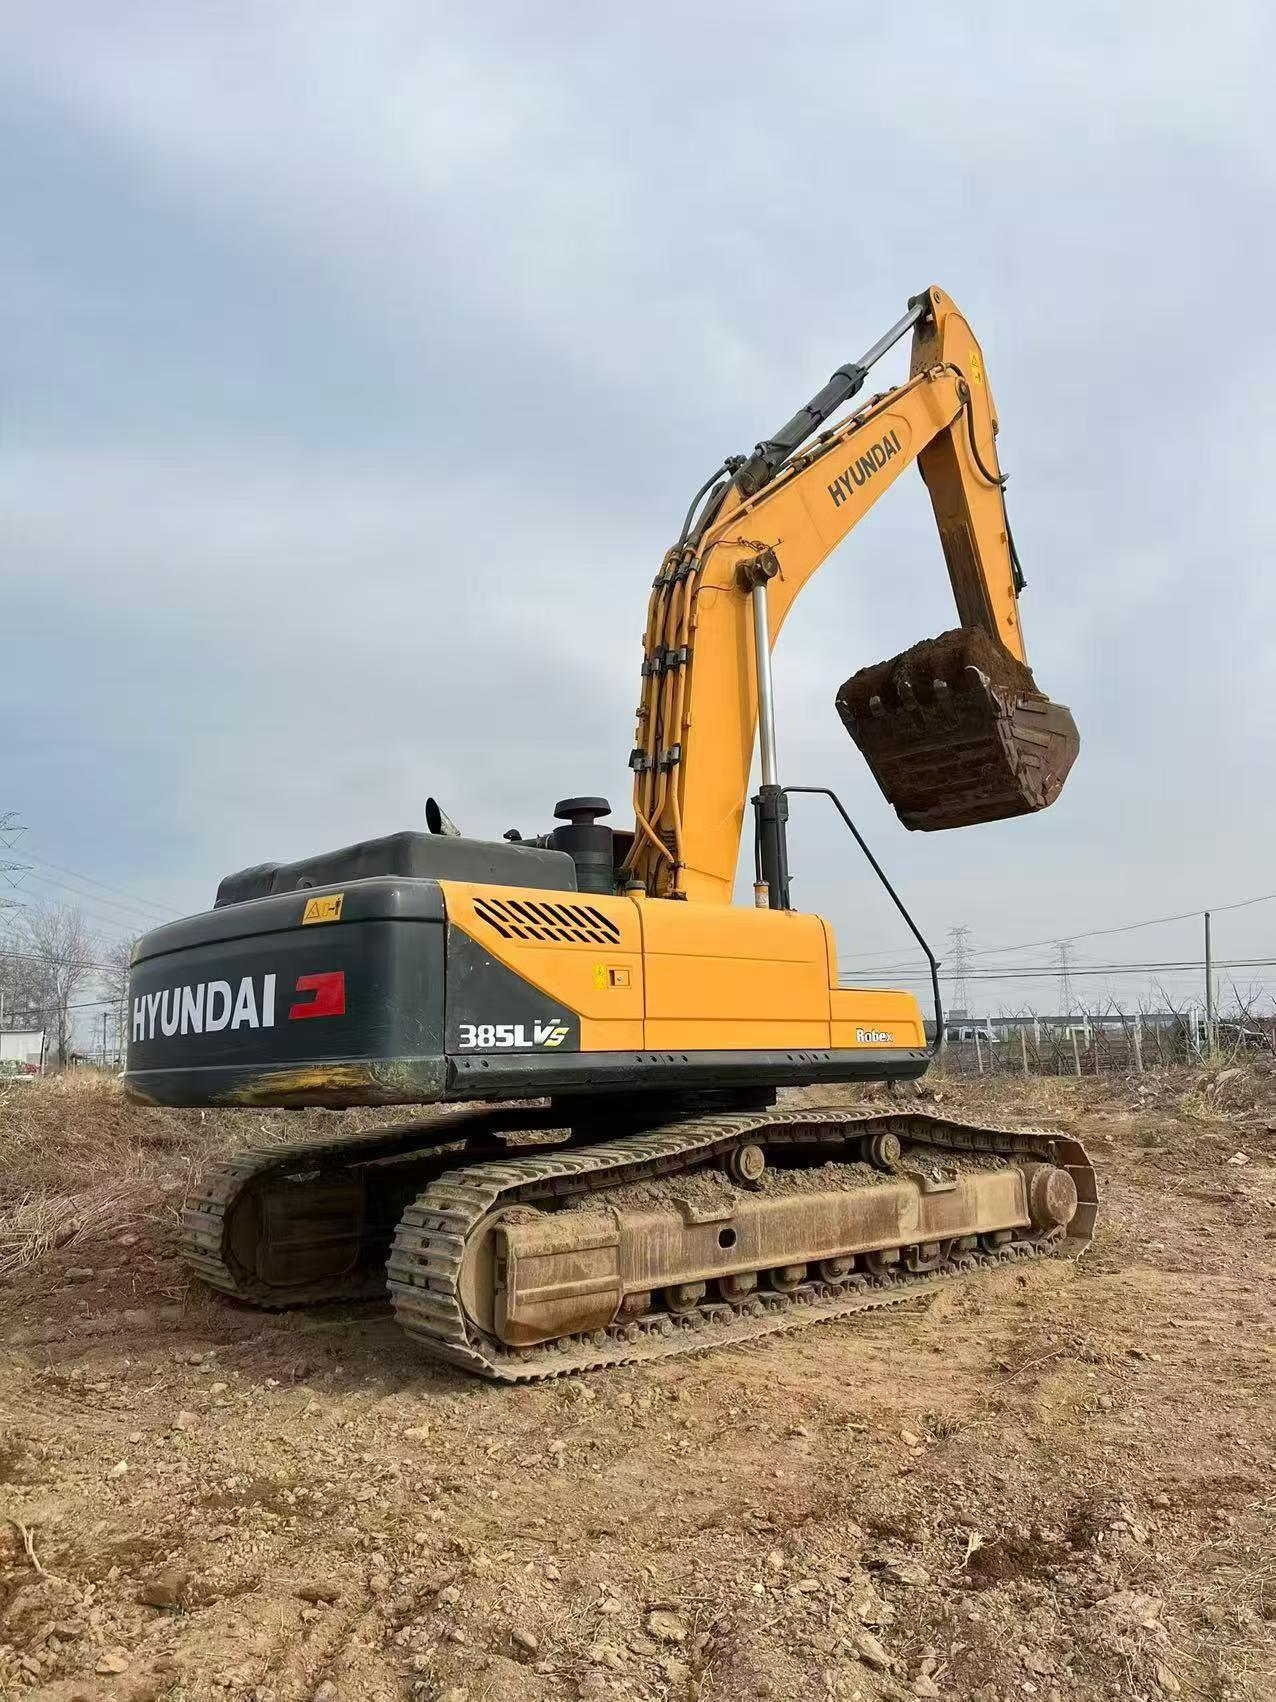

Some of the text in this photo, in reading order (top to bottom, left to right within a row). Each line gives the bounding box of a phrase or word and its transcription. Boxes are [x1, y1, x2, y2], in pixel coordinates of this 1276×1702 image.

[828, 430, 901, 507] HYUNDAI
[132, 974, 276, 1043] HYUNDAI
[856, 1028, 894, 1043] Robex
